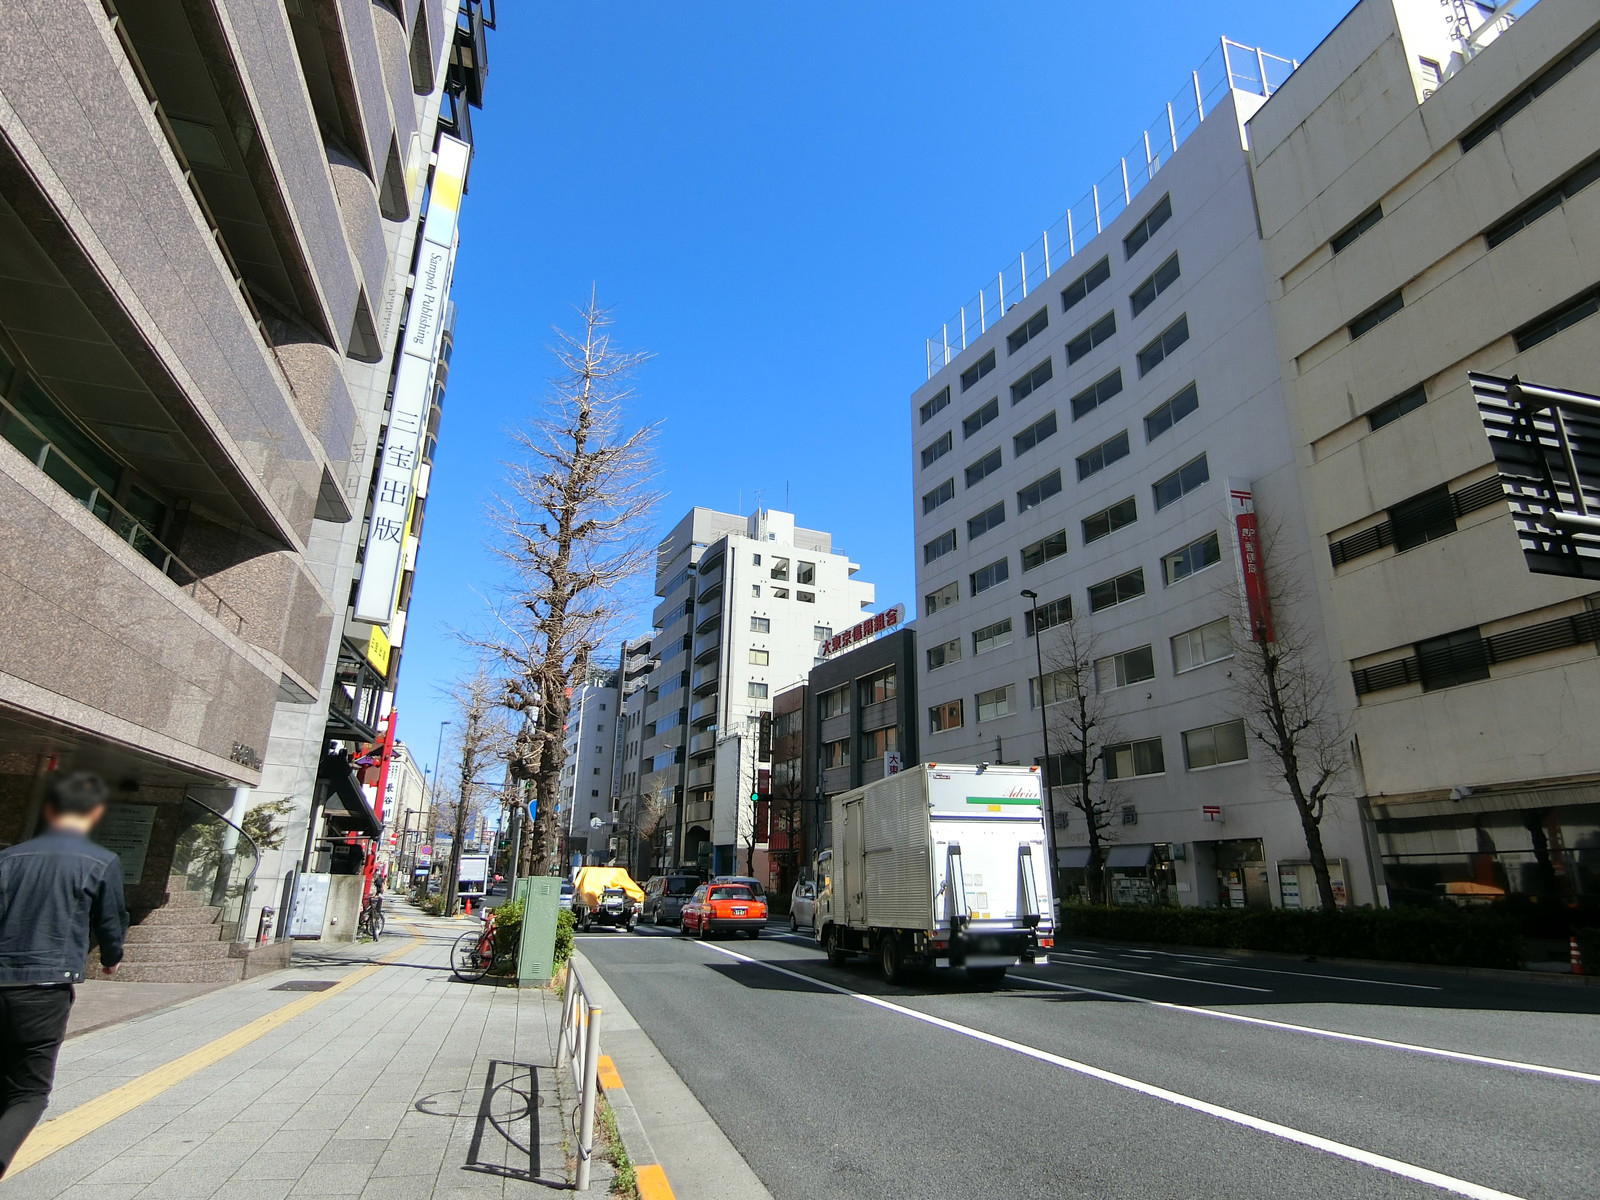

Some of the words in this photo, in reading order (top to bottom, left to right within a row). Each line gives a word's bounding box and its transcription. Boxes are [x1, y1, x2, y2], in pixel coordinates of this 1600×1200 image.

[425, 252, 443, 291] Sampoh
[413, 294, 435, 346] Publishing
[372, 410, 419, 544] 三宝出版
[822, 608, 898, 657] 大東京信用組合
